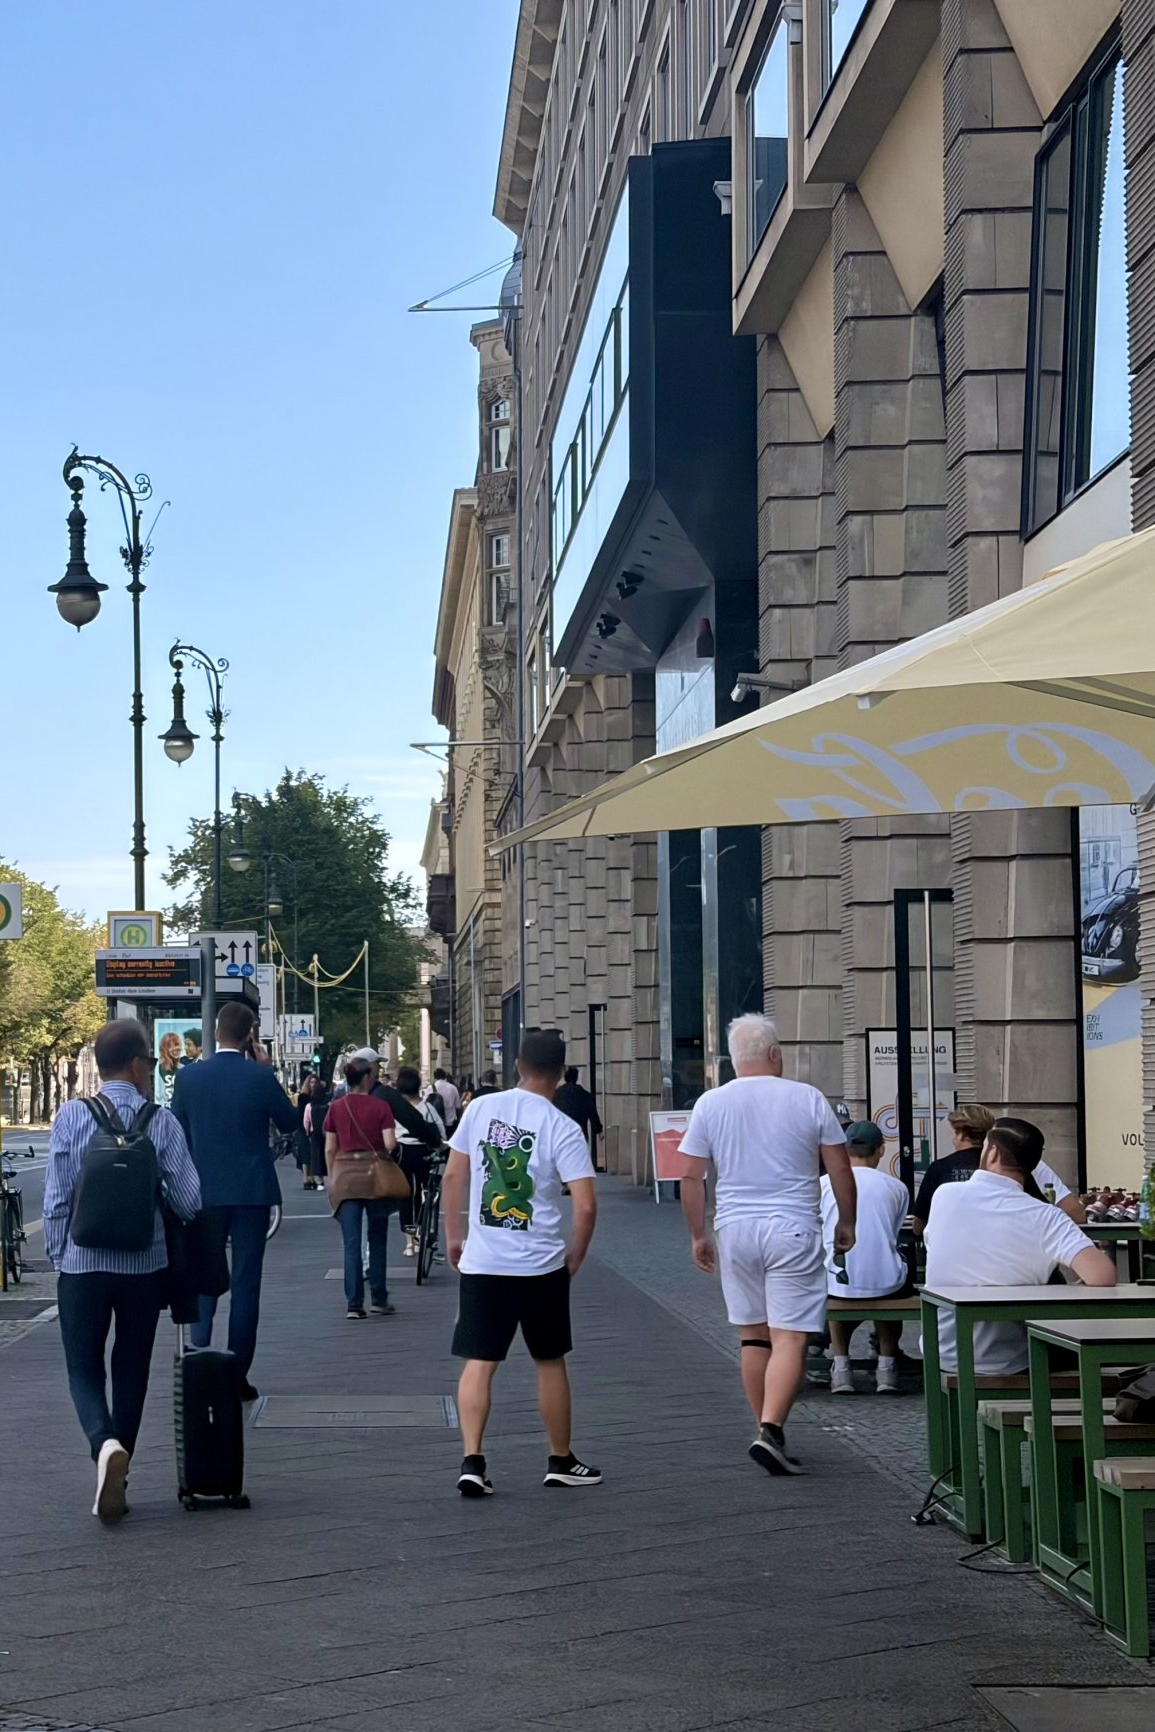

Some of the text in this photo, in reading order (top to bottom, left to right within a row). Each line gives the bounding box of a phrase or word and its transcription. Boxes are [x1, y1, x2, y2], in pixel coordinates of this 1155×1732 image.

[127, 929, 140, 944] H
[106, 960, 126, 970] Display
[127, 960, 152, 970] currently
